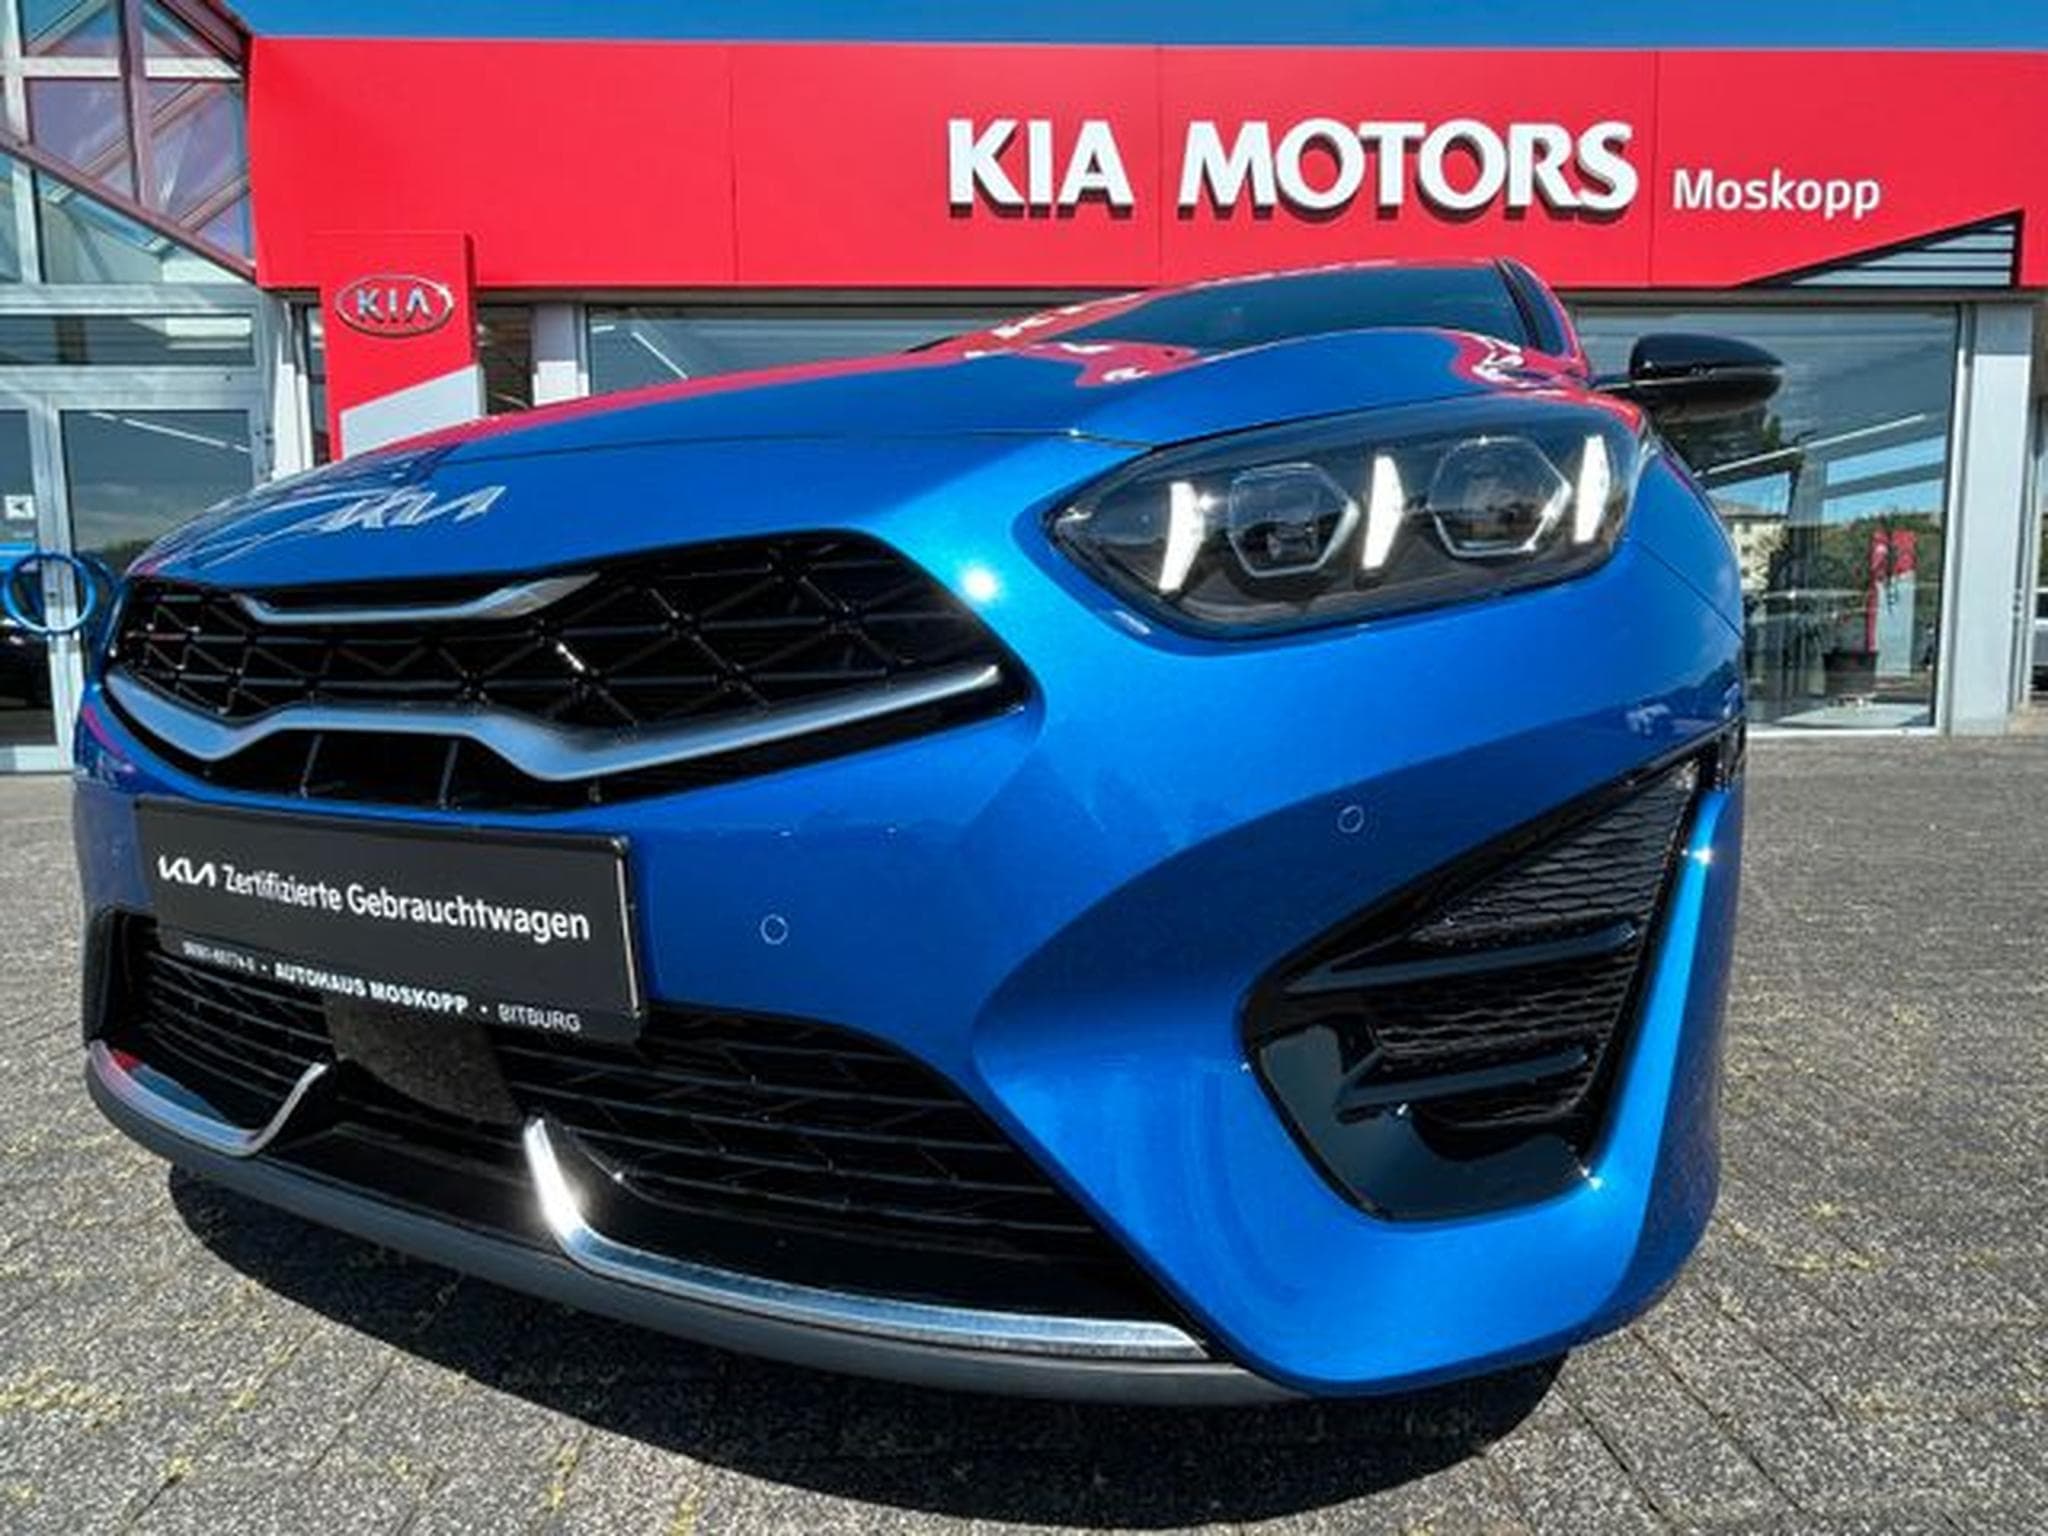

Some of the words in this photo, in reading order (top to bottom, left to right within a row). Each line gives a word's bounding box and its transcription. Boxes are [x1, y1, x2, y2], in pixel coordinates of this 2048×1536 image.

[946, 118, 1134, 212] KIA
[1178, 117, 1640, 216] MOTORS
[1673, 168, 1882, 219] Moskopp
[357, 287, 432, 318] KIA
[157, 855, 217, 888] KIA
[221, 863, 344, 912] Zertifizierte
[346, 882, 591, 944] Gebrauchtwagen
[274, 961, 367, 998] AUTOHAUS
[369, 979, 468, 1016] MOSKOPP
[498, 1002, 582, 1034] BITBURG
